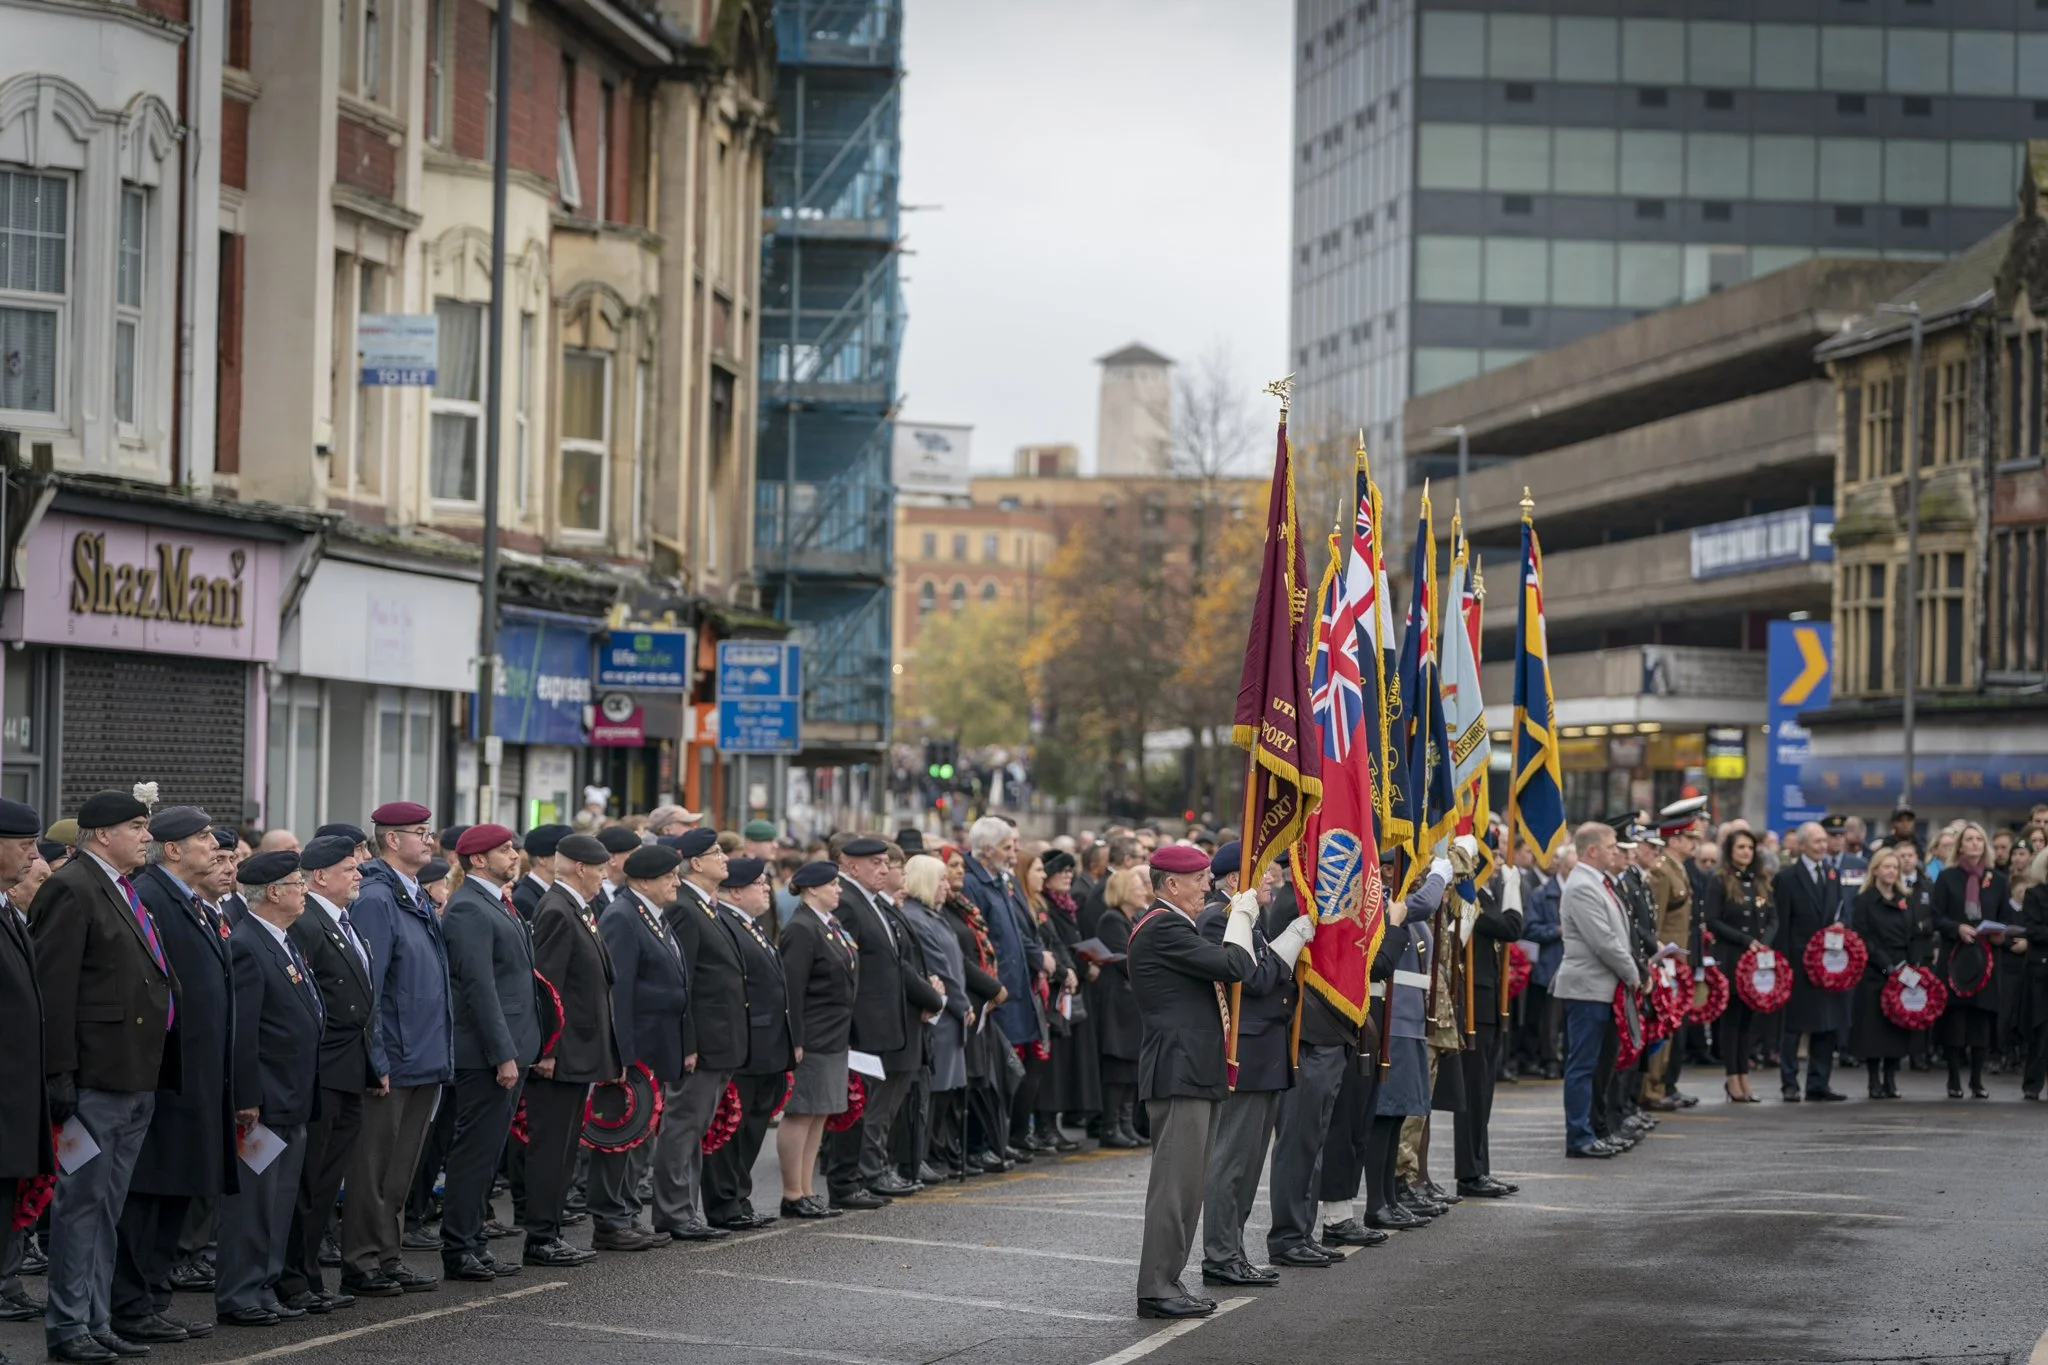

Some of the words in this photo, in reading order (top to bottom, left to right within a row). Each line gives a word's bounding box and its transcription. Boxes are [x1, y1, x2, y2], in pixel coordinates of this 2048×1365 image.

[377, 369, 400, 385] TO
[401, 369, 428, 385] LET
[70, 531, 244, 629] ShazMani
[1261, 717, 1297, 753] PORT
[1251, 794, 1291, 864] WPORT
